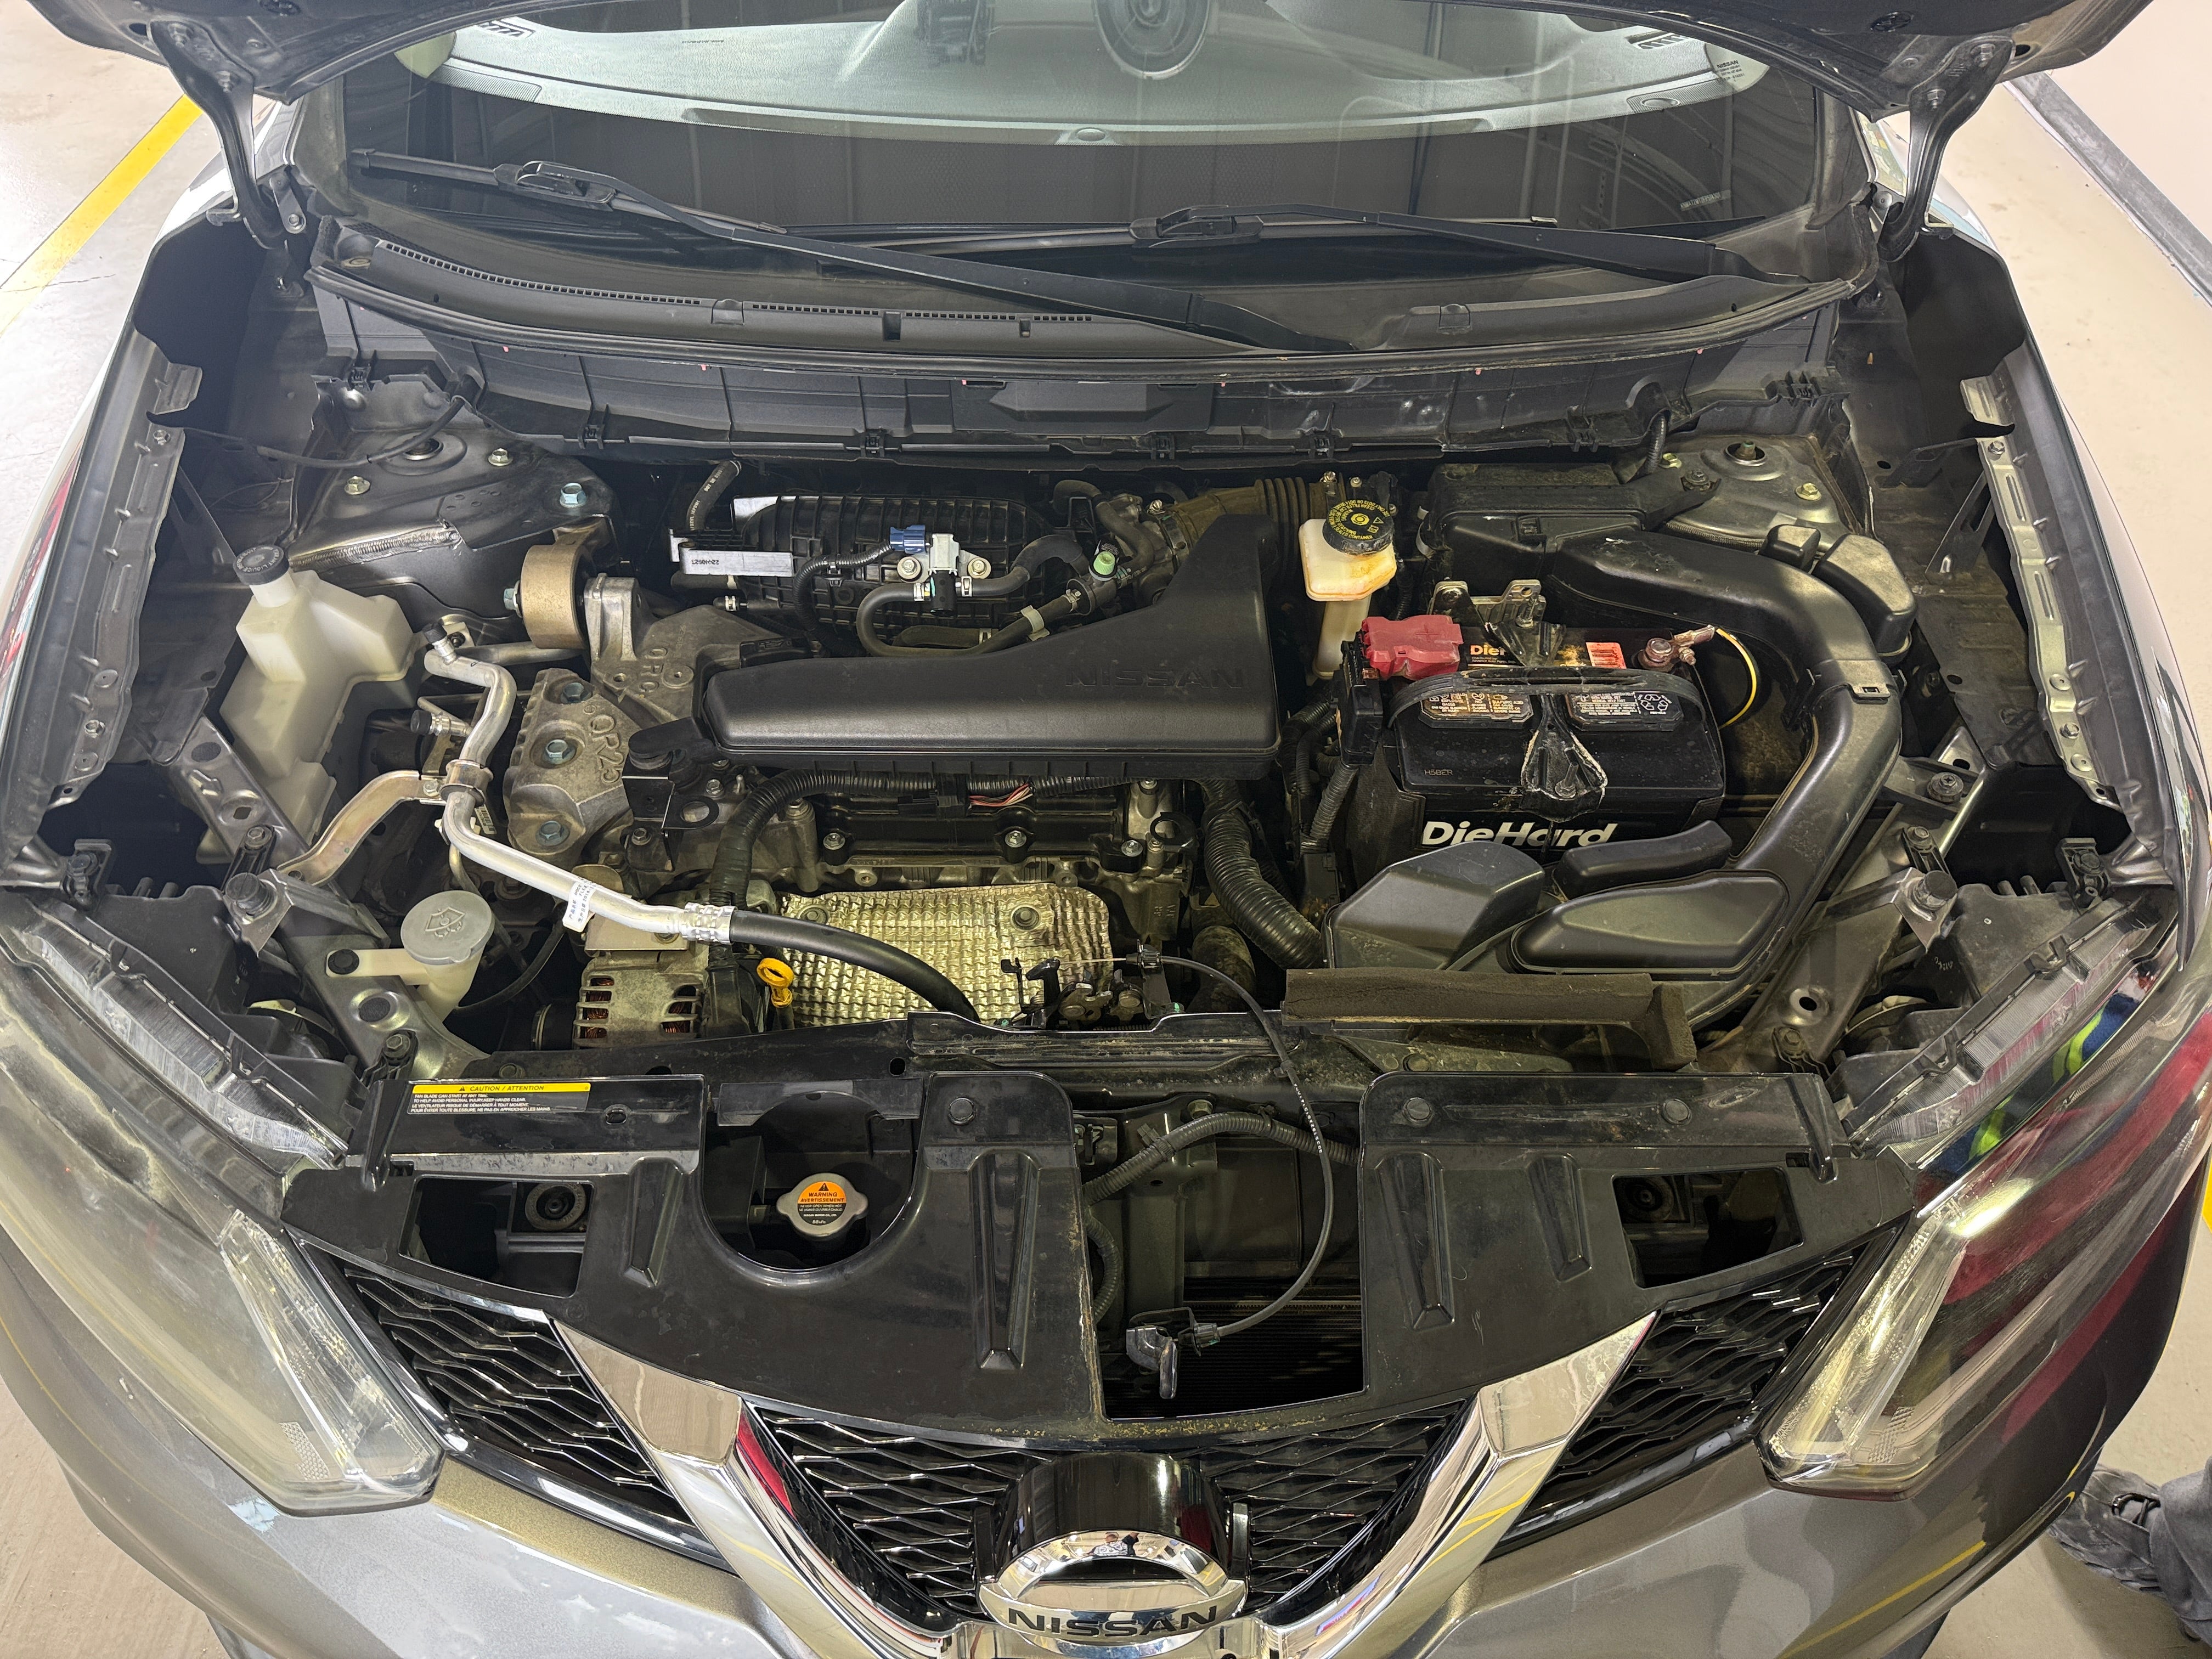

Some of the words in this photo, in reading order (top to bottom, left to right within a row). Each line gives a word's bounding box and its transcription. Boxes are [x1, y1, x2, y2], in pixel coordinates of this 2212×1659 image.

[1717, 60, 1739, 69] NISSAN
[1065, 670, 1243, 689] NISSAN
[589, 714, 625, 784] QR25
[1421, 821, 1618, 847] DieHard
[1008, 1605, 1217, 1637] NISSAN
